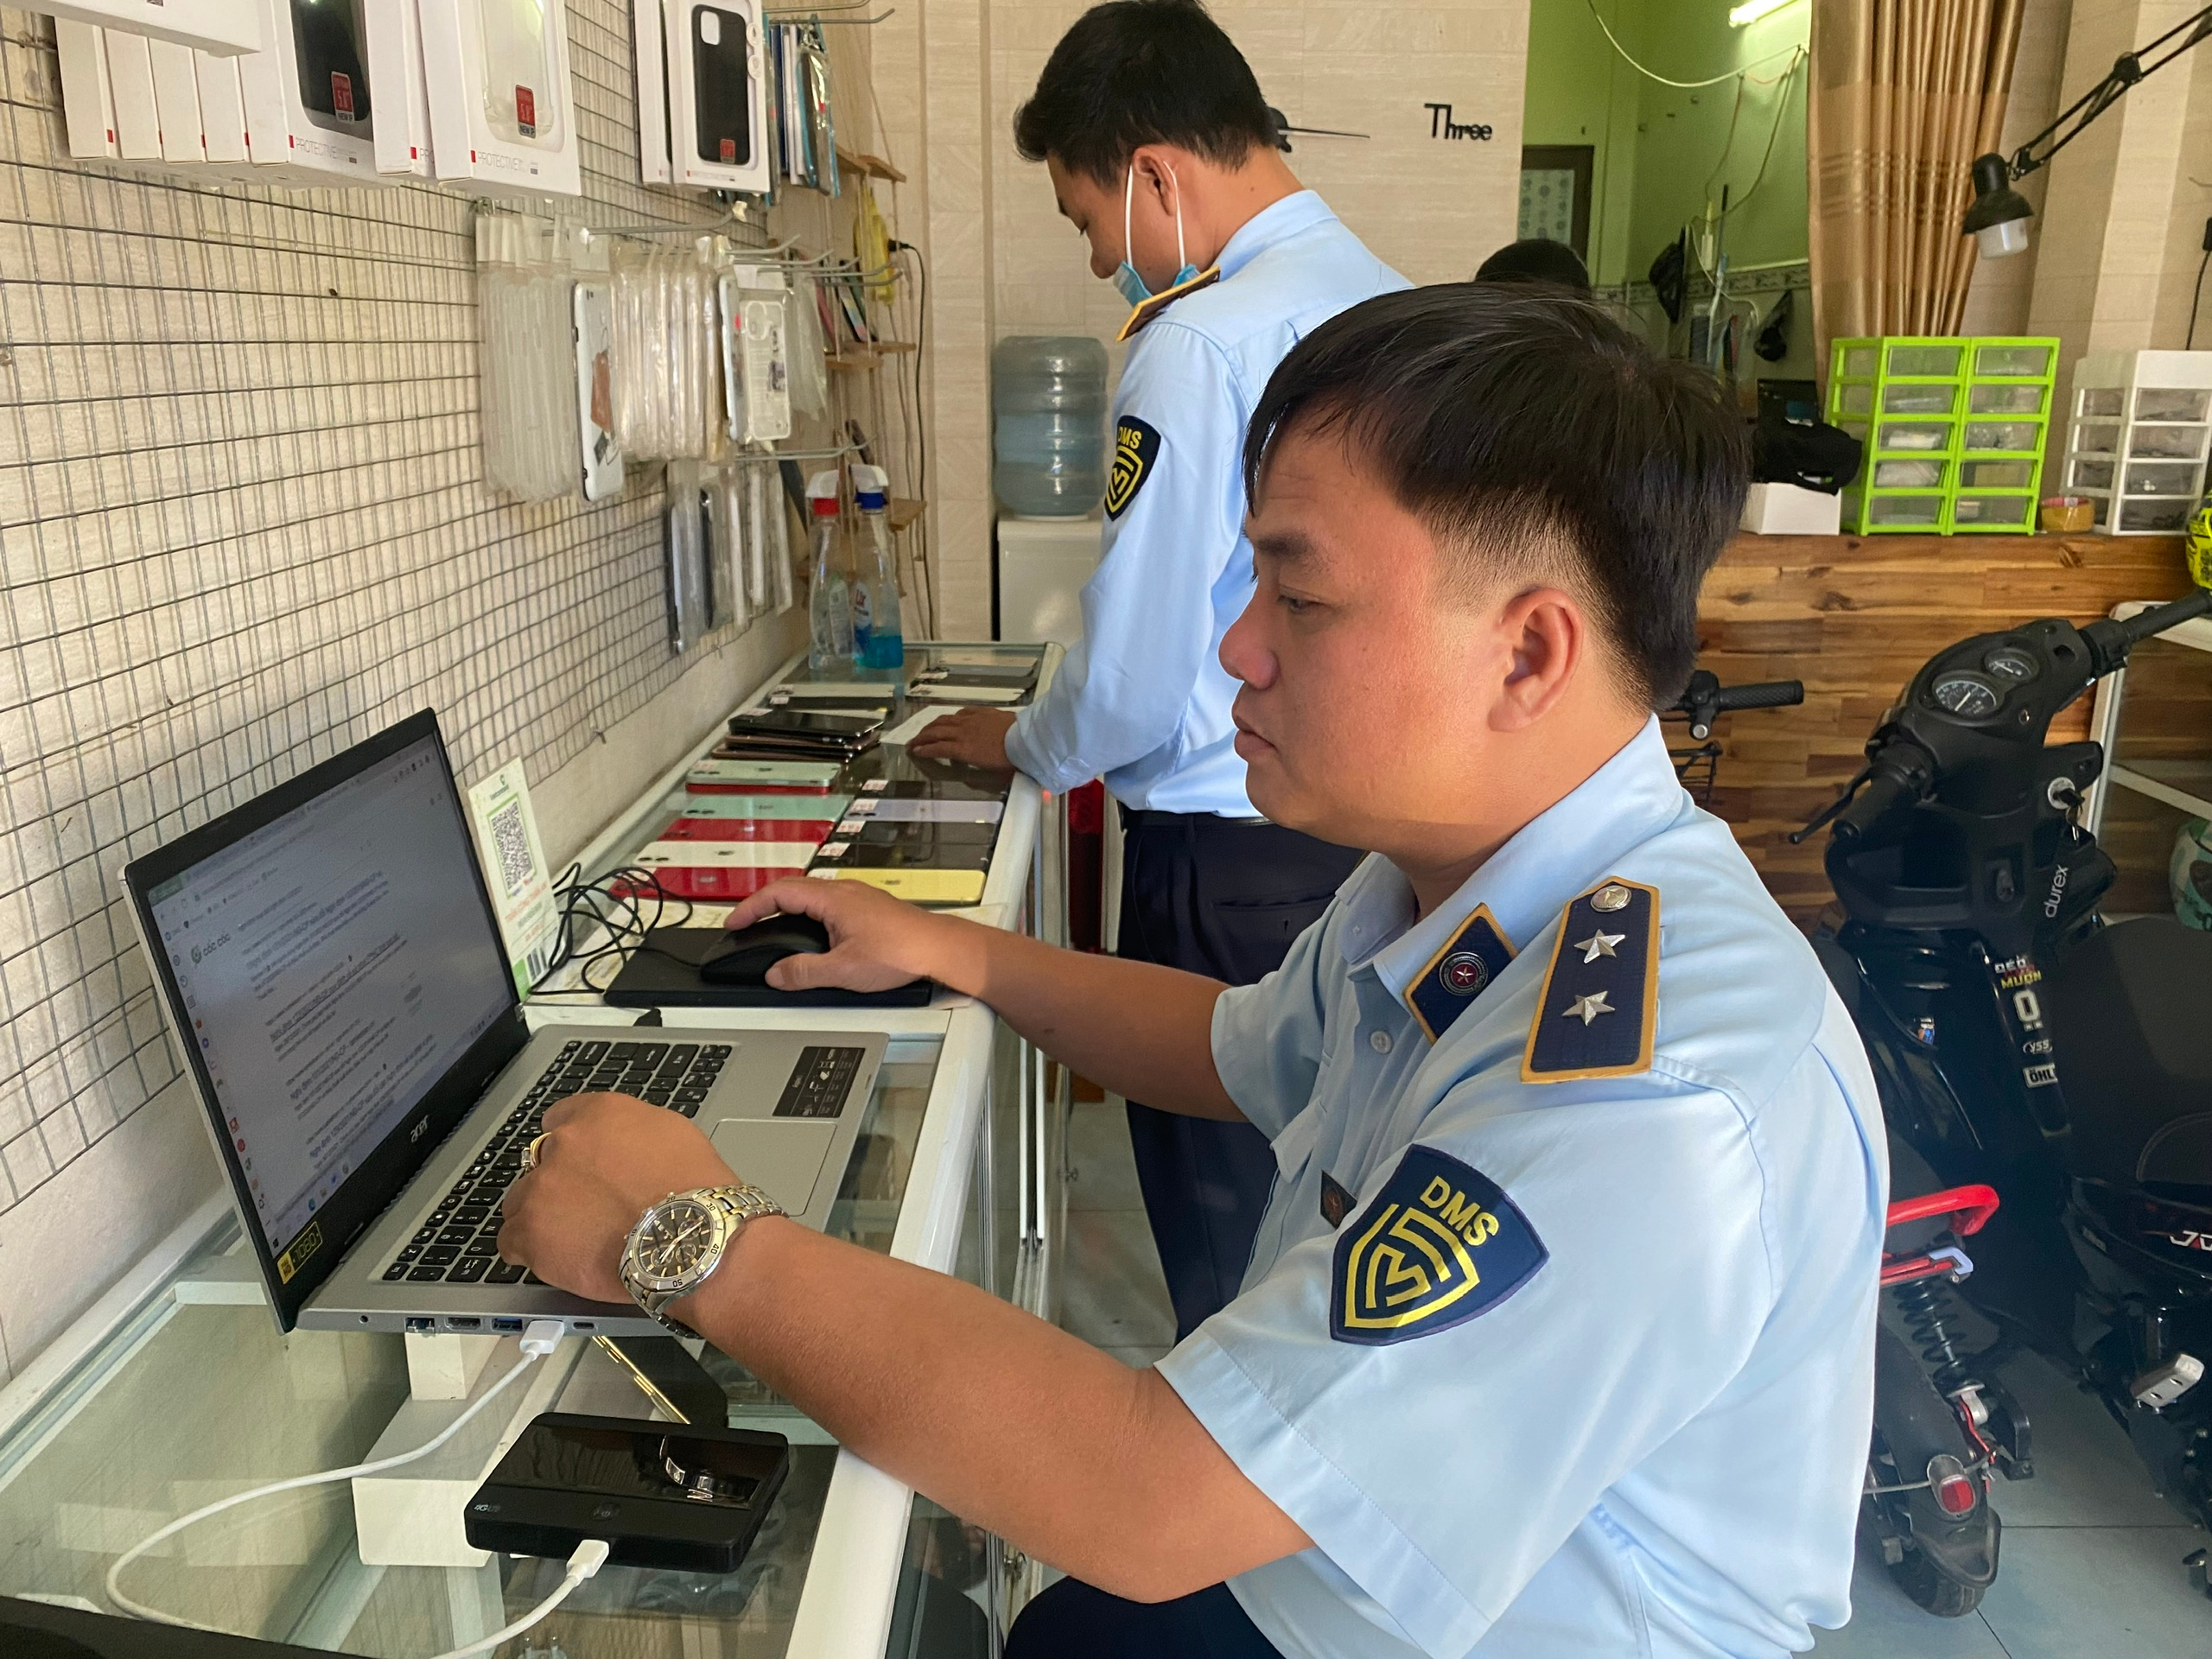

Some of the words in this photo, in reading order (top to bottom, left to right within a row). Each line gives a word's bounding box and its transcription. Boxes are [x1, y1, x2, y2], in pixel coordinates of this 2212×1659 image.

[1424, 103, 1492, 141] Three
[296, 137, 338, 159] PROTECTIVE
[477, 151, 518, 171] PROTECTIVE
[1117, 426, 1141, 449] DMS
[2044, 865, 2069, 918] durex
[410, 1114, 429, 1142] acer
[706, 1202, 716, 1211] 30
[1420, 1176, 1499, 1246] DMS
[710, 1243, 720, 1255] 40
[672, 1279, 683, 1287] 50
